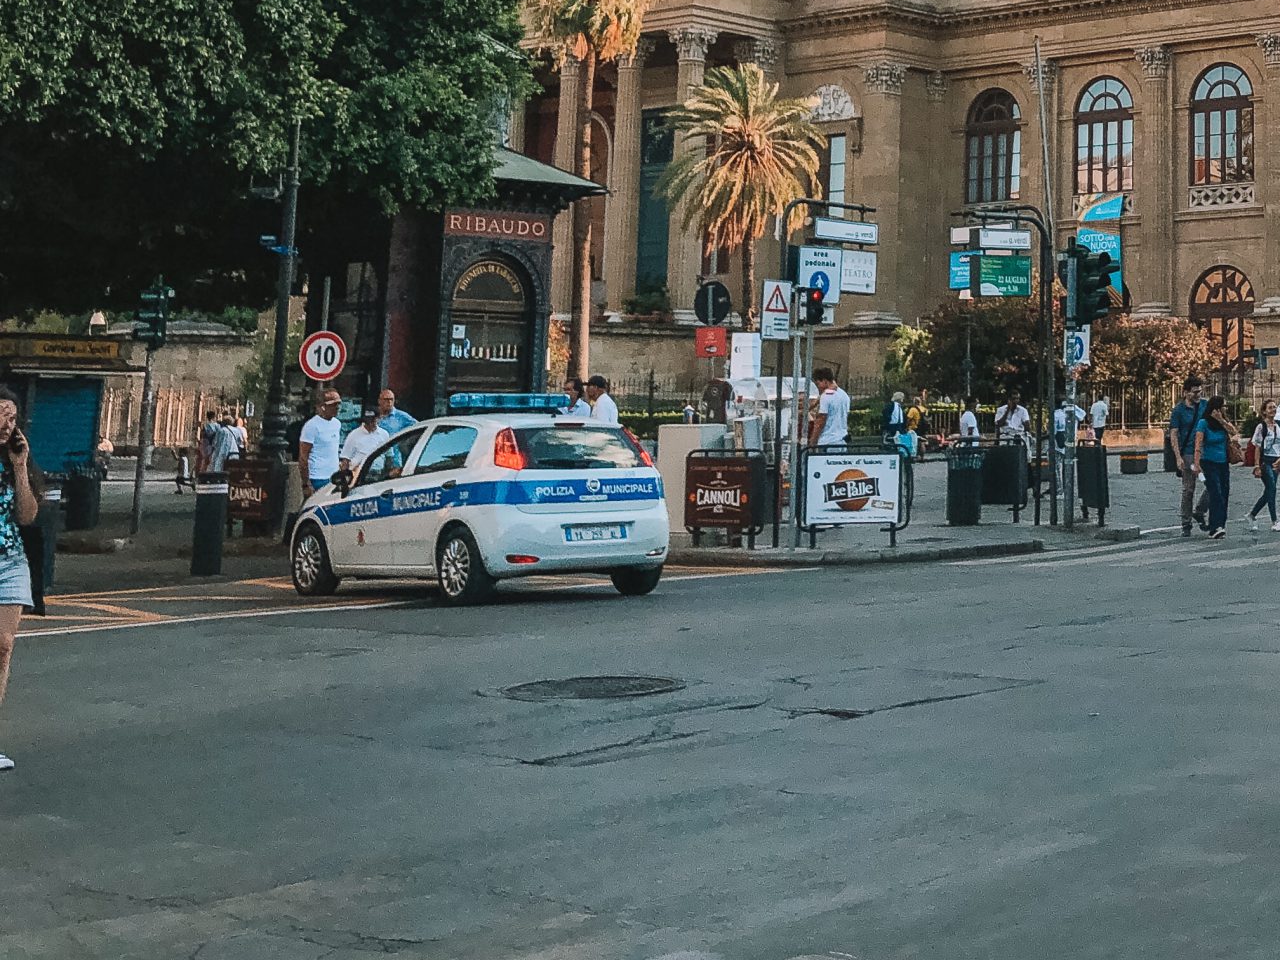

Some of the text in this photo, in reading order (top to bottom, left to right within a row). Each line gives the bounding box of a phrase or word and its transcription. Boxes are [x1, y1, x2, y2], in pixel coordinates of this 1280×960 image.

[449, 214, 545, 237] RIBAUDO
[1080, 233, 1105, 243] SOTTO
[1090, 241, 1118, 250] NUOVA
[813, 250, 829, 258] area
[804, 259, 836, 267] pedonale
[843, 268, 873, 279] TEATRO
[1005, 275, 1027, 285] LUGLIO
[313, 344, 336, 368] 10
[229, 486, 263, 503] CANNOLI
[535, 483, 654, 497] POLIZIA MUNICIPALE
[830, 480, 875, 498] ke Palle
[350, 500, 379, 517] POLIZIA
[392, 490, 442, 511] MUNICIPALE
[696, 488, 741, 507] CANNOLI
